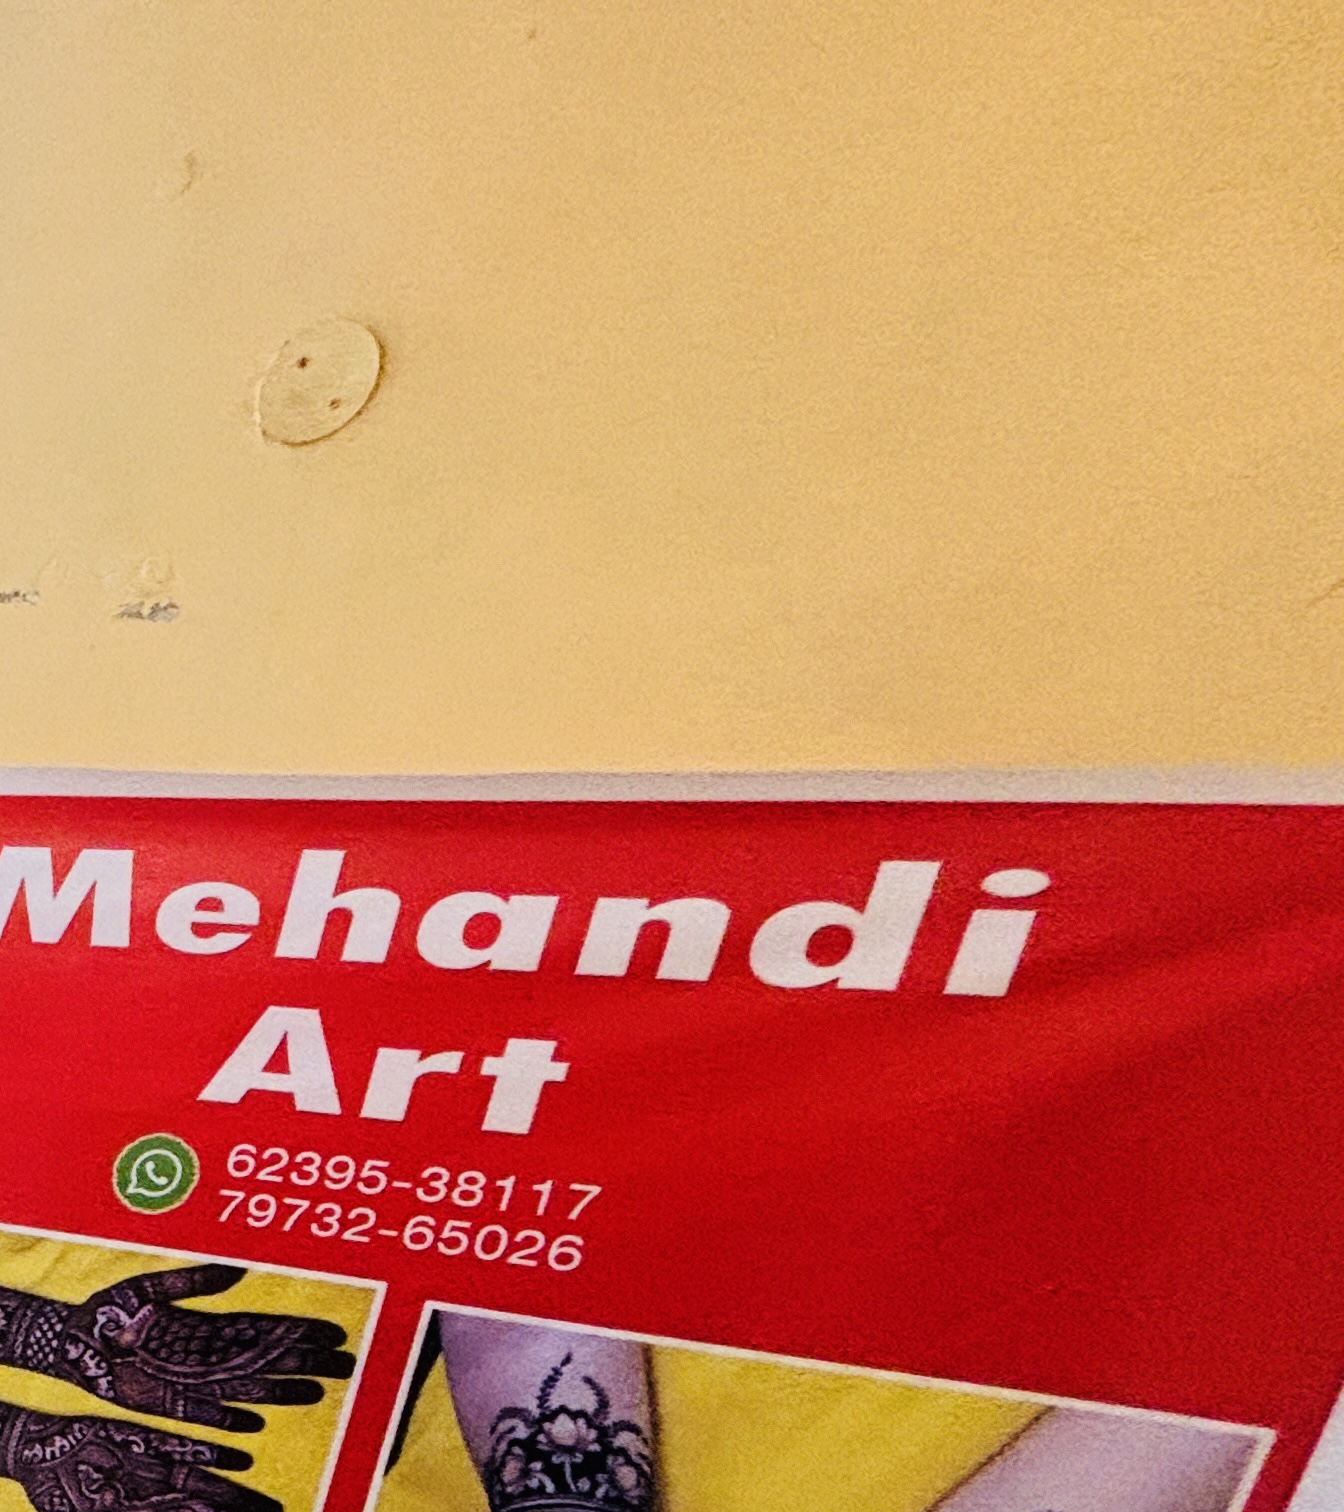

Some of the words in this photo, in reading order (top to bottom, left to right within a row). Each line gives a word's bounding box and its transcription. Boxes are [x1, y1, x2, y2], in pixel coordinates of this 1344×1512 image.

[196, 1004, 571, 1136] Art
[225, 1143, 603, 1223] 62395-38117
[217, 1189, 586, 1273] 79732-65026
